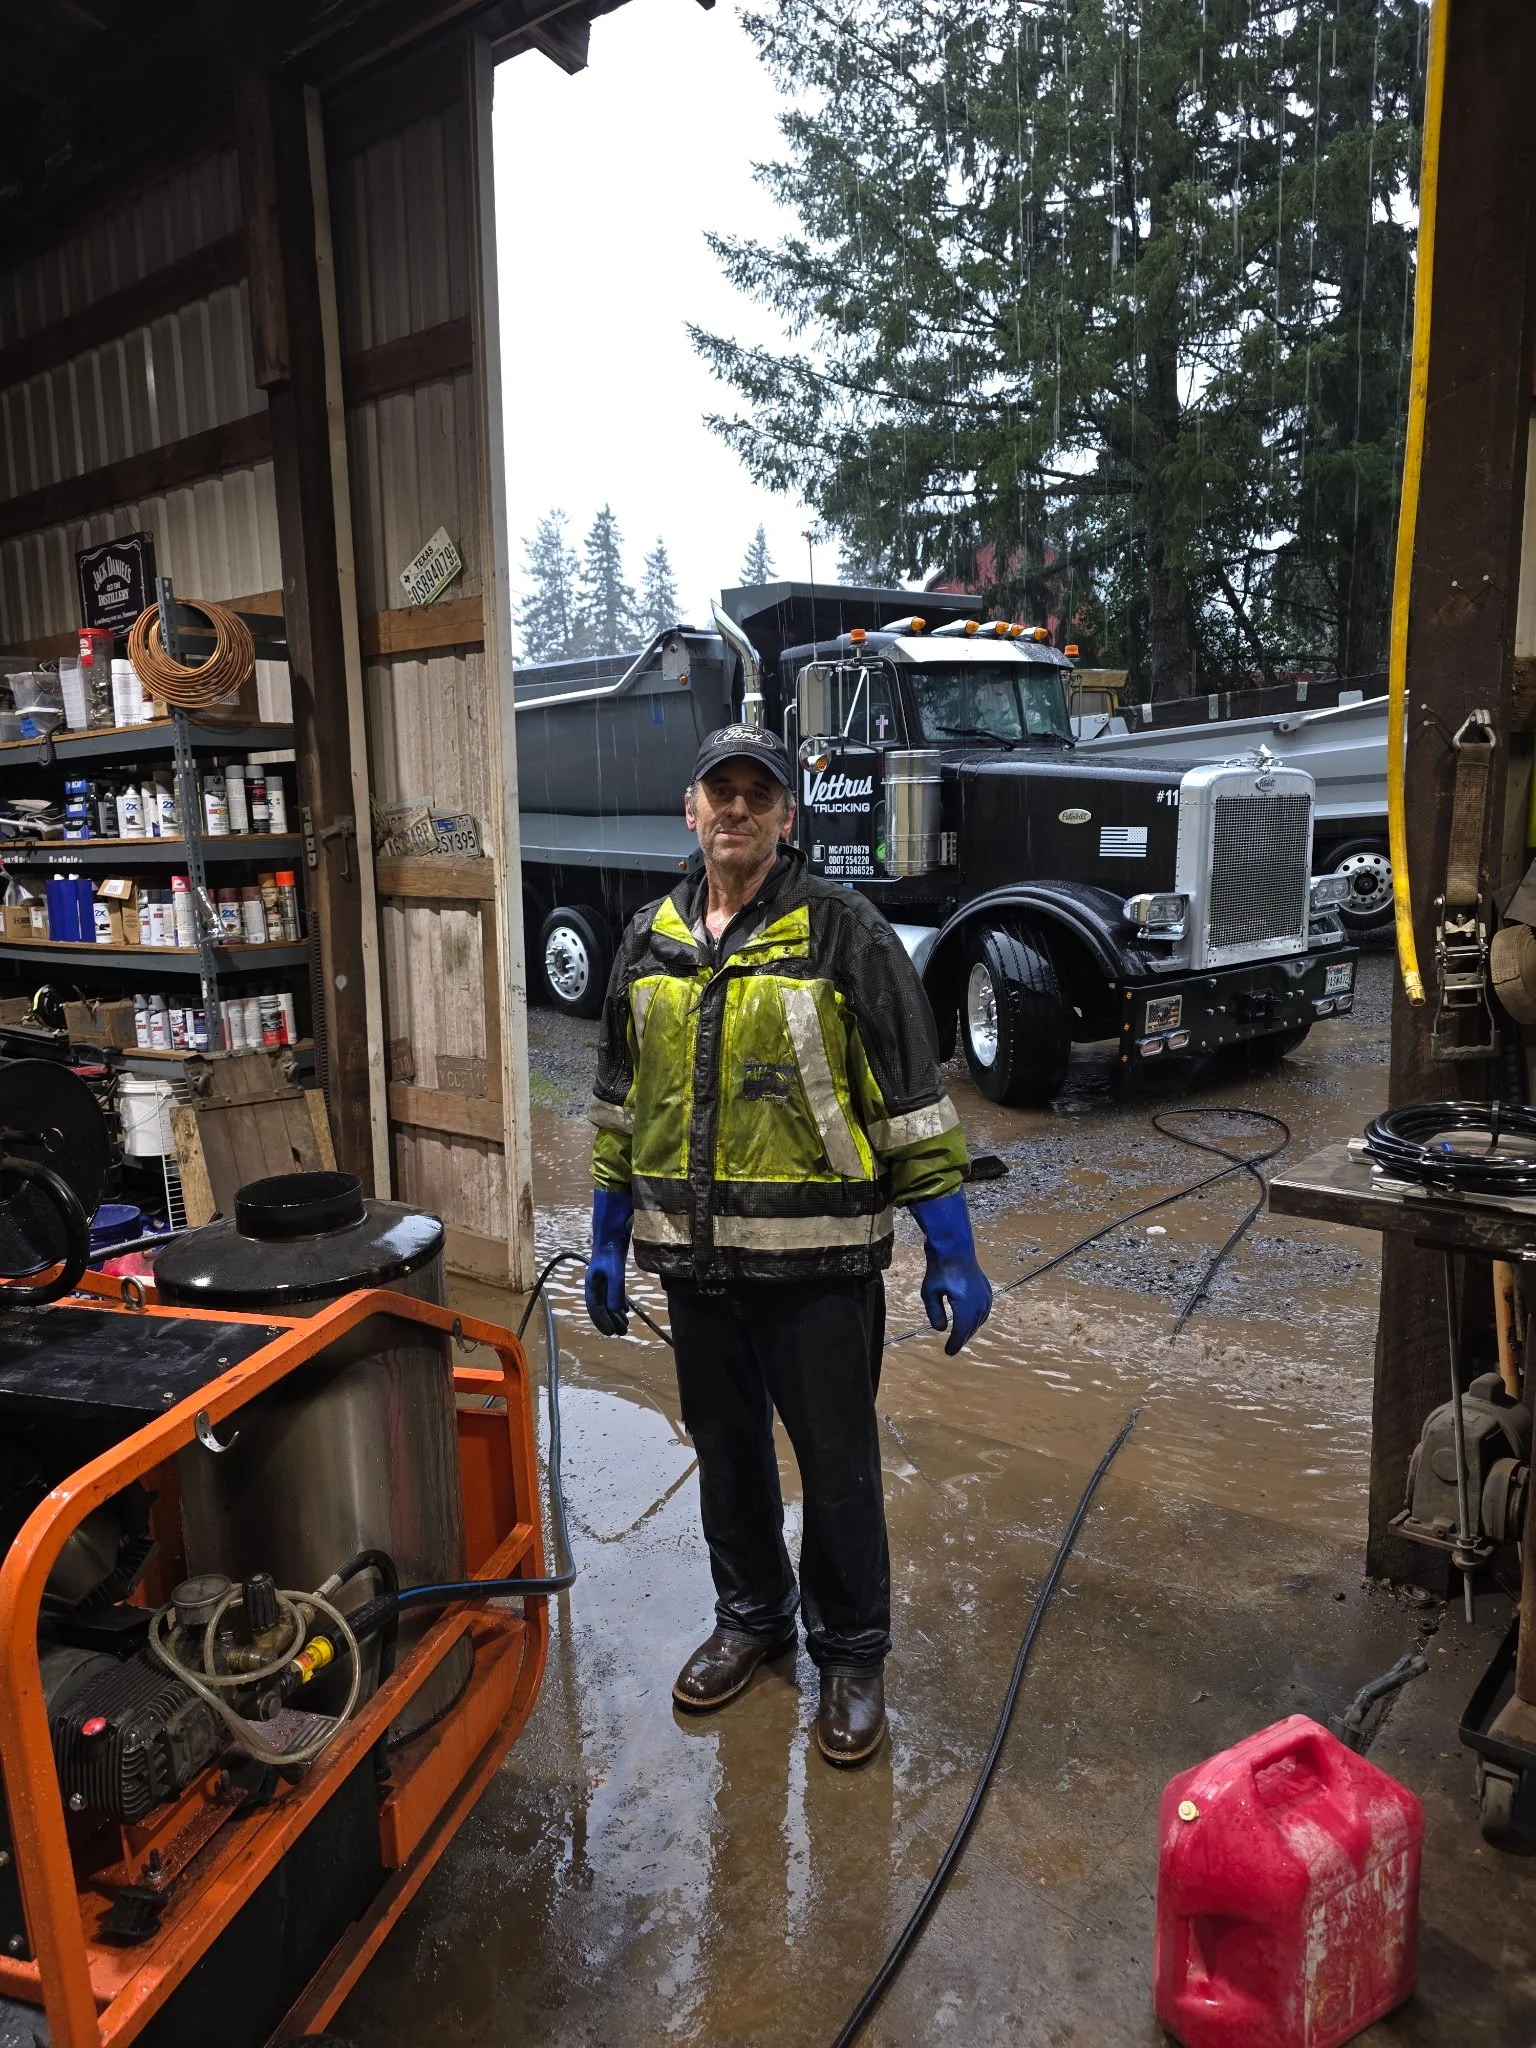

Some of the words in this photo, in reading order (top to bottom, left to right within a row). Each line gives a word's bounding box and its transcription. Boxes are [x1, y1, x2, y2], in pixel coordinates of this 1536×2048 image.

[413, 545, 435, 570] TEXAS
[92, 562, 108, 592] JACK
[723, 726, 763, 741] Ford
[803, 769, 874, 806] Vettrus
[1156, 789, 1179, 806] #11
[125, 802, 138, 811] 2X
[812, 802, 871, 813] TRUCKING
[828, 845, 870, 855] MC#1078879
[828, 855, 845, 865] ODOT
[845, 855, 870, 865] 254220
[824, 865, 844, 875] USDOT
[222, 909, 236, 918] 2X
